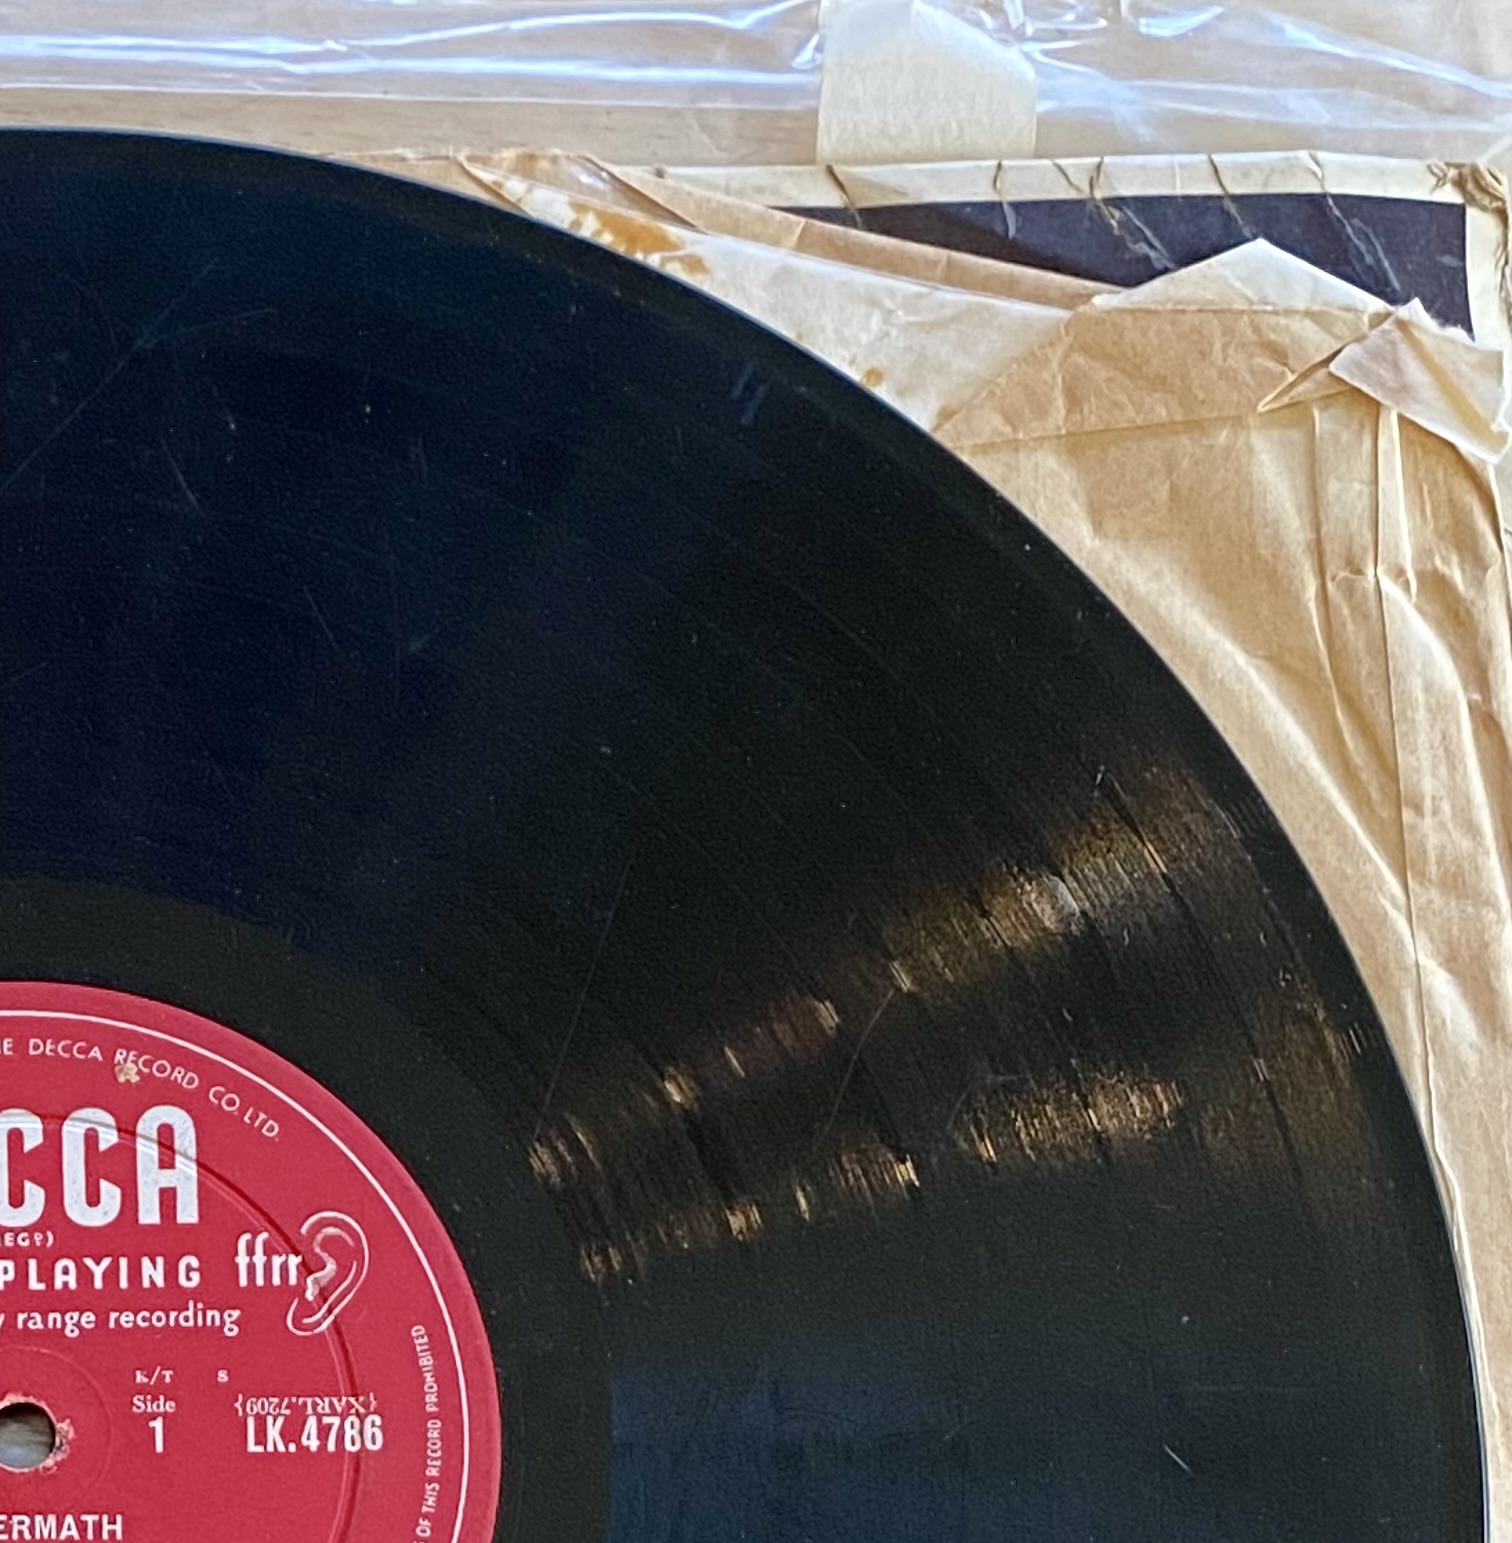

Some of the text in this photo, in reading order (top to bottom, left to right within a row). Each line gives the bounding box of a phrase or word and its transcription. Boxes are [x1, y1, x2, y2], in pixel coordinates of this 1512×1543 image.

[28, 1038, 103, 1061] DECCA
[114, 1049, 199, 1088] RECORD
[234, 1231, 302, 1287] ffrr
[17, 1308, 96, 1338] range
[109, 1300, 241, 1337] recording
[410, 1324, 439, 1412] PROHIBITED
[132, 1394, 176, 1413] Side
[149, 1416, 164, 1453] 1
[246, 1414, 383, 1453] LK.4786
[425, 1419, 442, 1477] RECORD
[421, 1482, 440, 1513] THIS
[415, 1517, 432, 1537] OF
